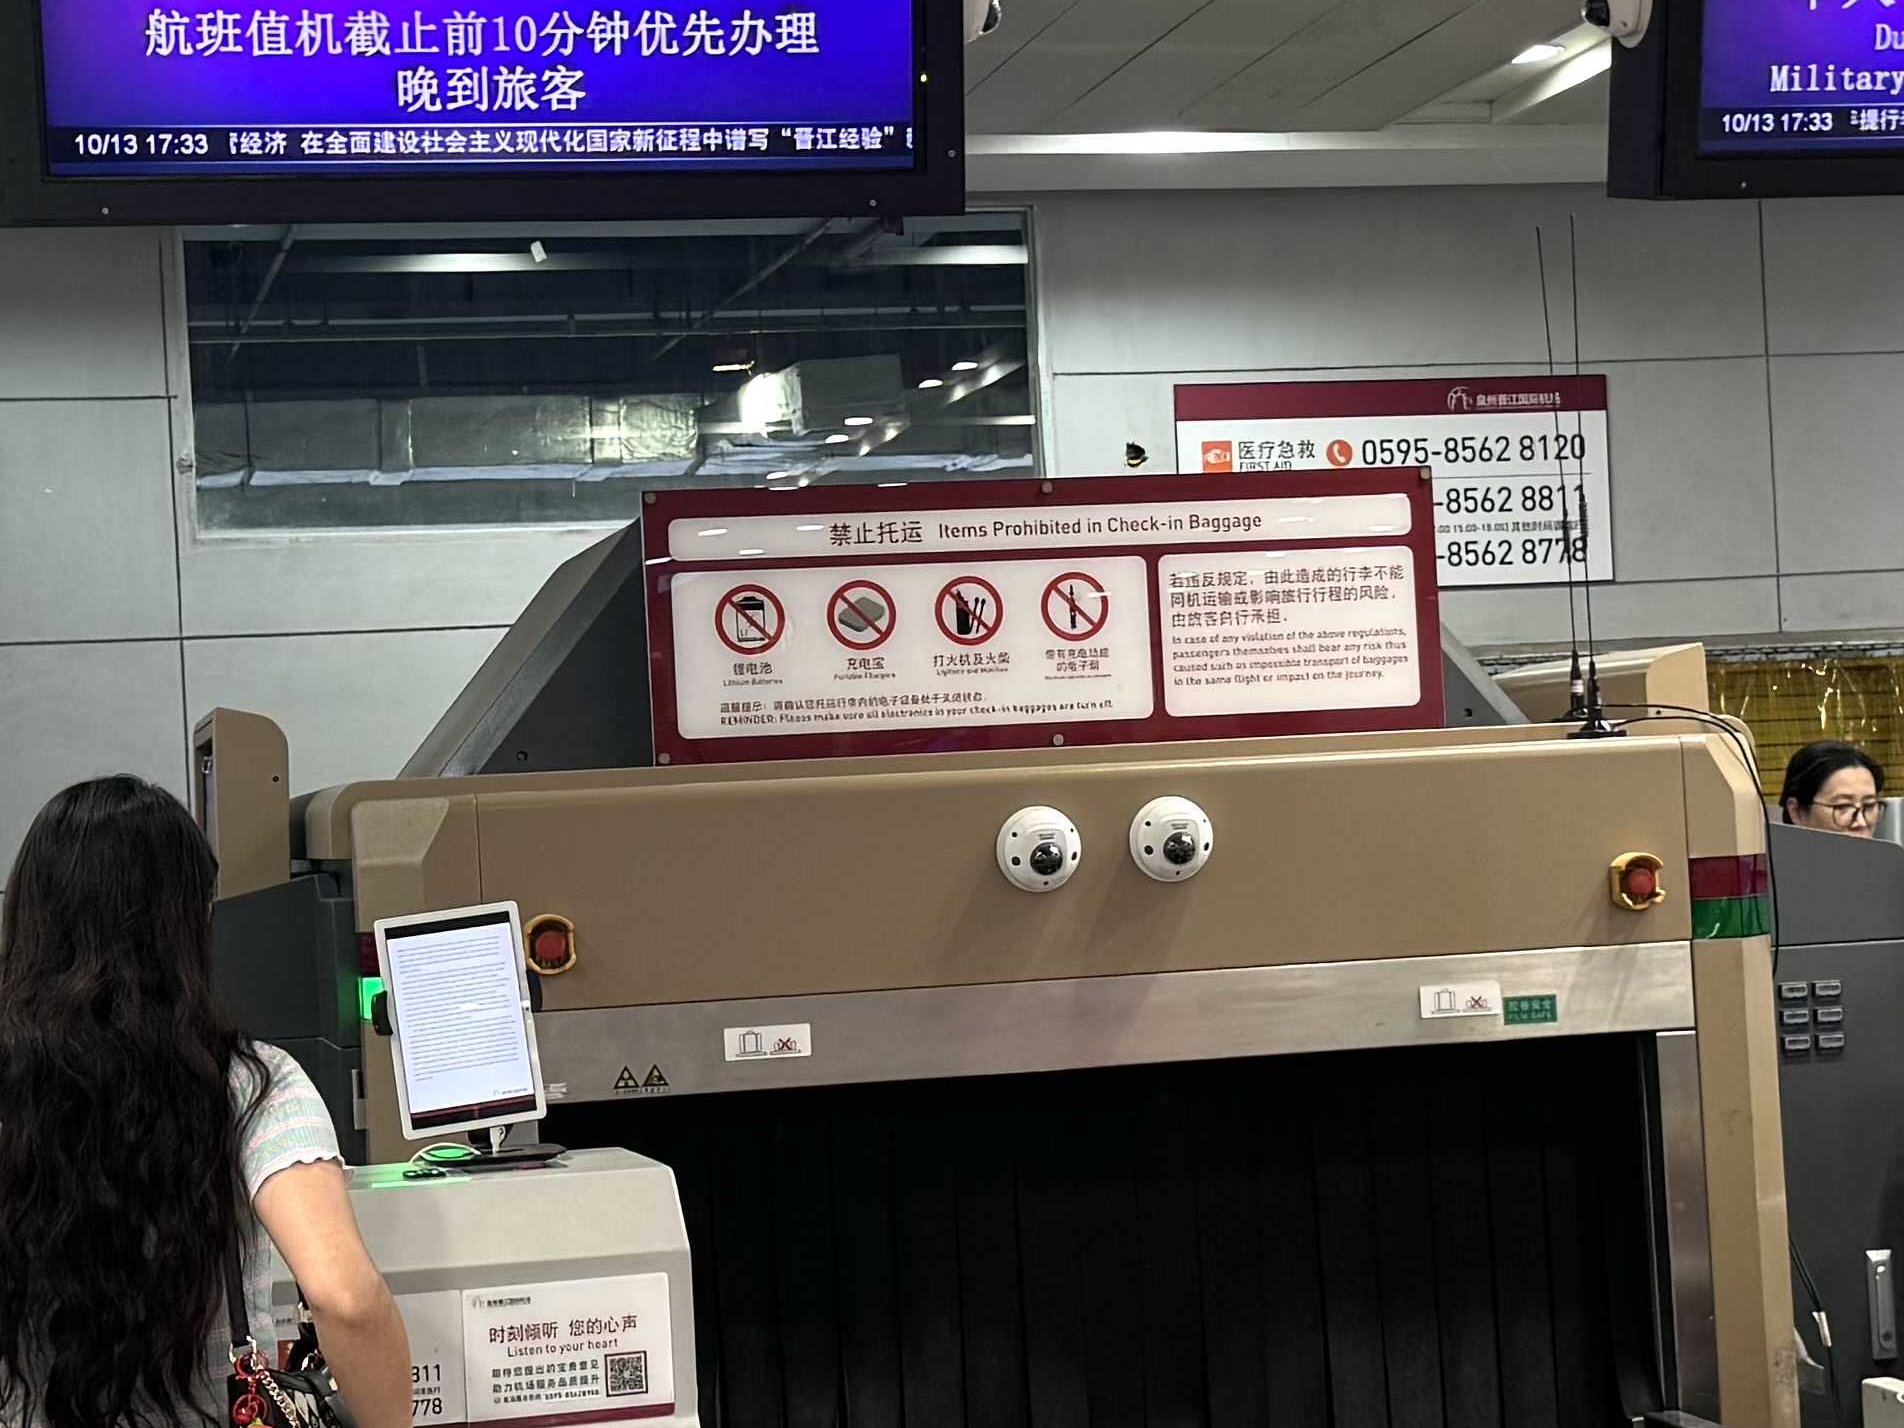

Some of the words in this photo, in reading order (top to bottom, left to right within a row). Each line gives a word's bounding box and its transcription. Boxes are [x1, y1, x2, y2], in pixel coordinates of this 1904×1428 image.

[144, 8, 821, 58] 航班值机截止前10分钟优先办理
[395, 65, 587, 113] 晚到旅客
[1721, 112, 1775, 133] 10/13
[1780, 112, 1834, 132] 17:33
[74, 134, 138, 156] 10/13
[145, 133, 209, 156] 17:33
[1238, 440, 1315, 460] 医疗急救
[1361, 437, 1513, 467] 0595-8562
[1519, 433, 1586, 461] 8120
[1434, 488, 1514, 514] -8562
[1521, 484, 1586, 512] 8811
[829, 520, 924, 547] 禁止托运
[939, 522, 988, 539] Items
[993, 517, 1081, 538] Prohibited
[1086, 518, 1103, 534] in
[1107, 514, 1182, 534] Check-in
[1188, 513, 1263, 532] Baggage
[1437, 540, 1515, 567] -8562
[1521, 535, 1587, 564] 8778
[932, 651, 1011, 668] 打火机及火柴
[489, 1322, 559, 1344] 时刻倾听
[568, 1314, 638, 1338] 您的心声
[507, 1345, 543, 1358] Listen
[545, 1343, 557, 1355] to
[559, 1341, 584, 1356] your
[587, 1338, 619, 1350] heart
[411, 1397, 443, 1417] 778
